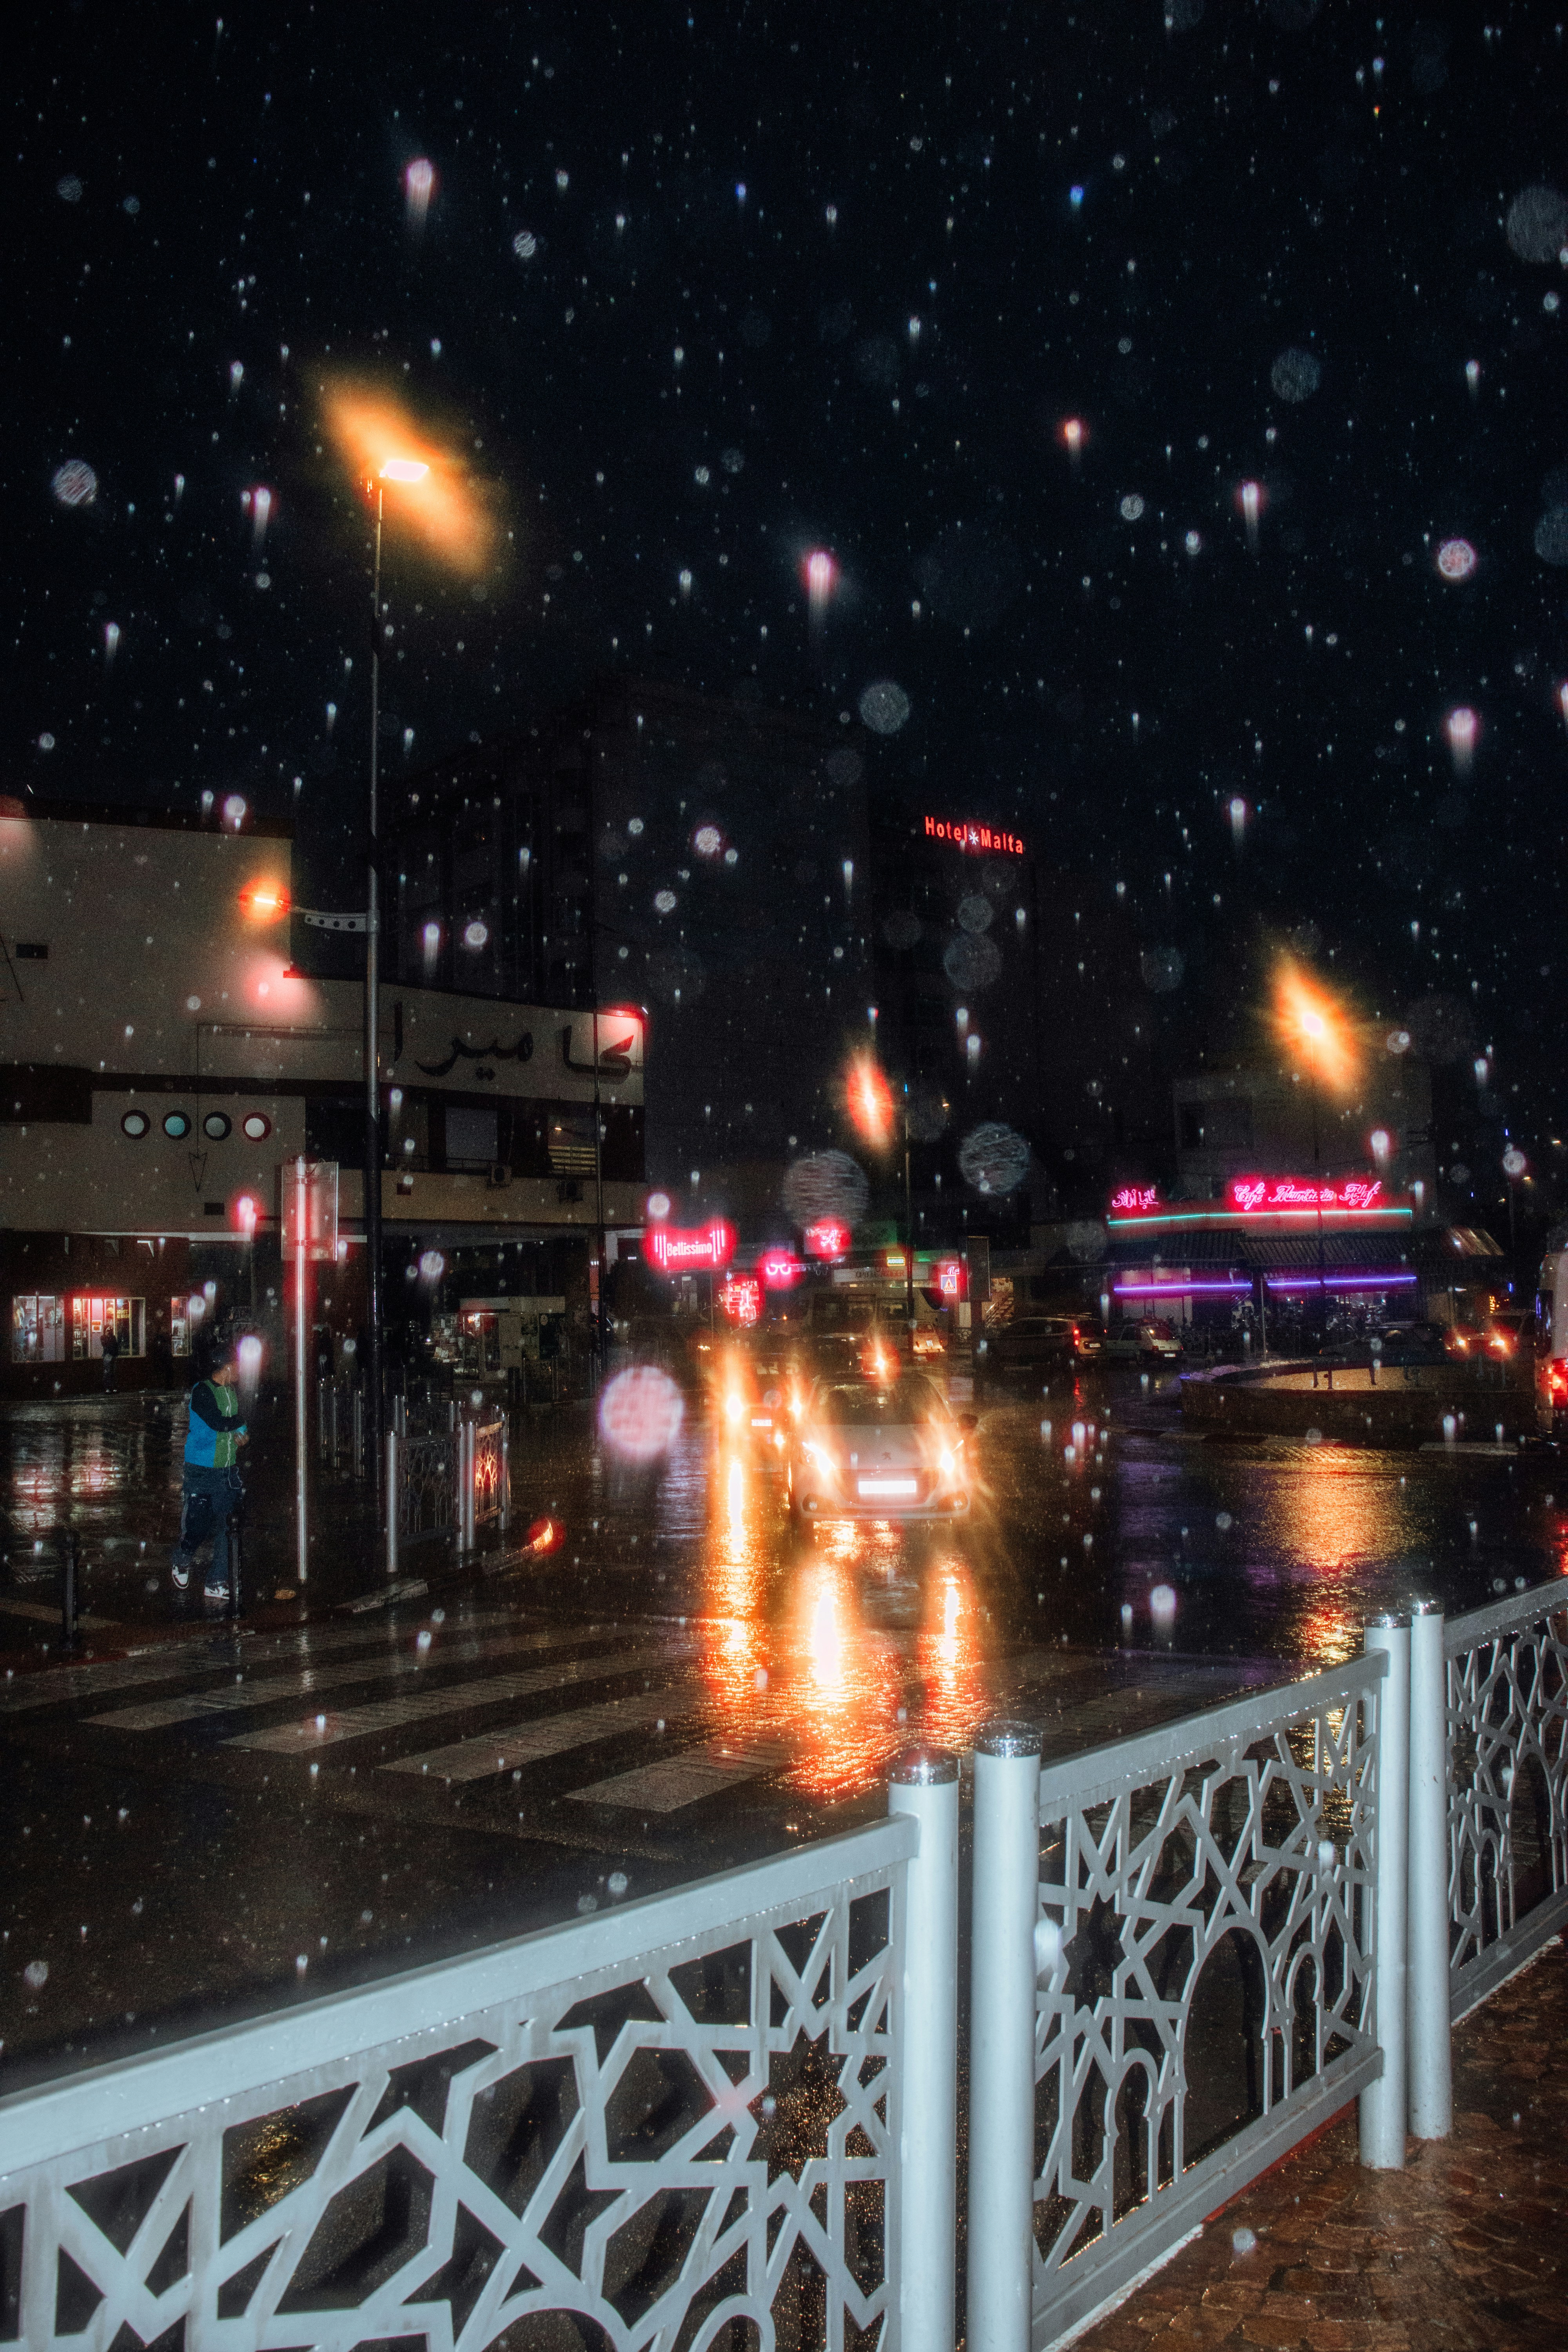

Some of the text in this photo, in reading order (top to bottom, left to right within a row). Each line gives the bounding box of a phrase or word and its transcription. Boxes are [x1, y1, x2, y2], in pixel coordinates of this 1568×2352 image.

[926, 816, 1023, 854] Hotel Malta
[666, 1241, 713, 1257] Bellissimo
